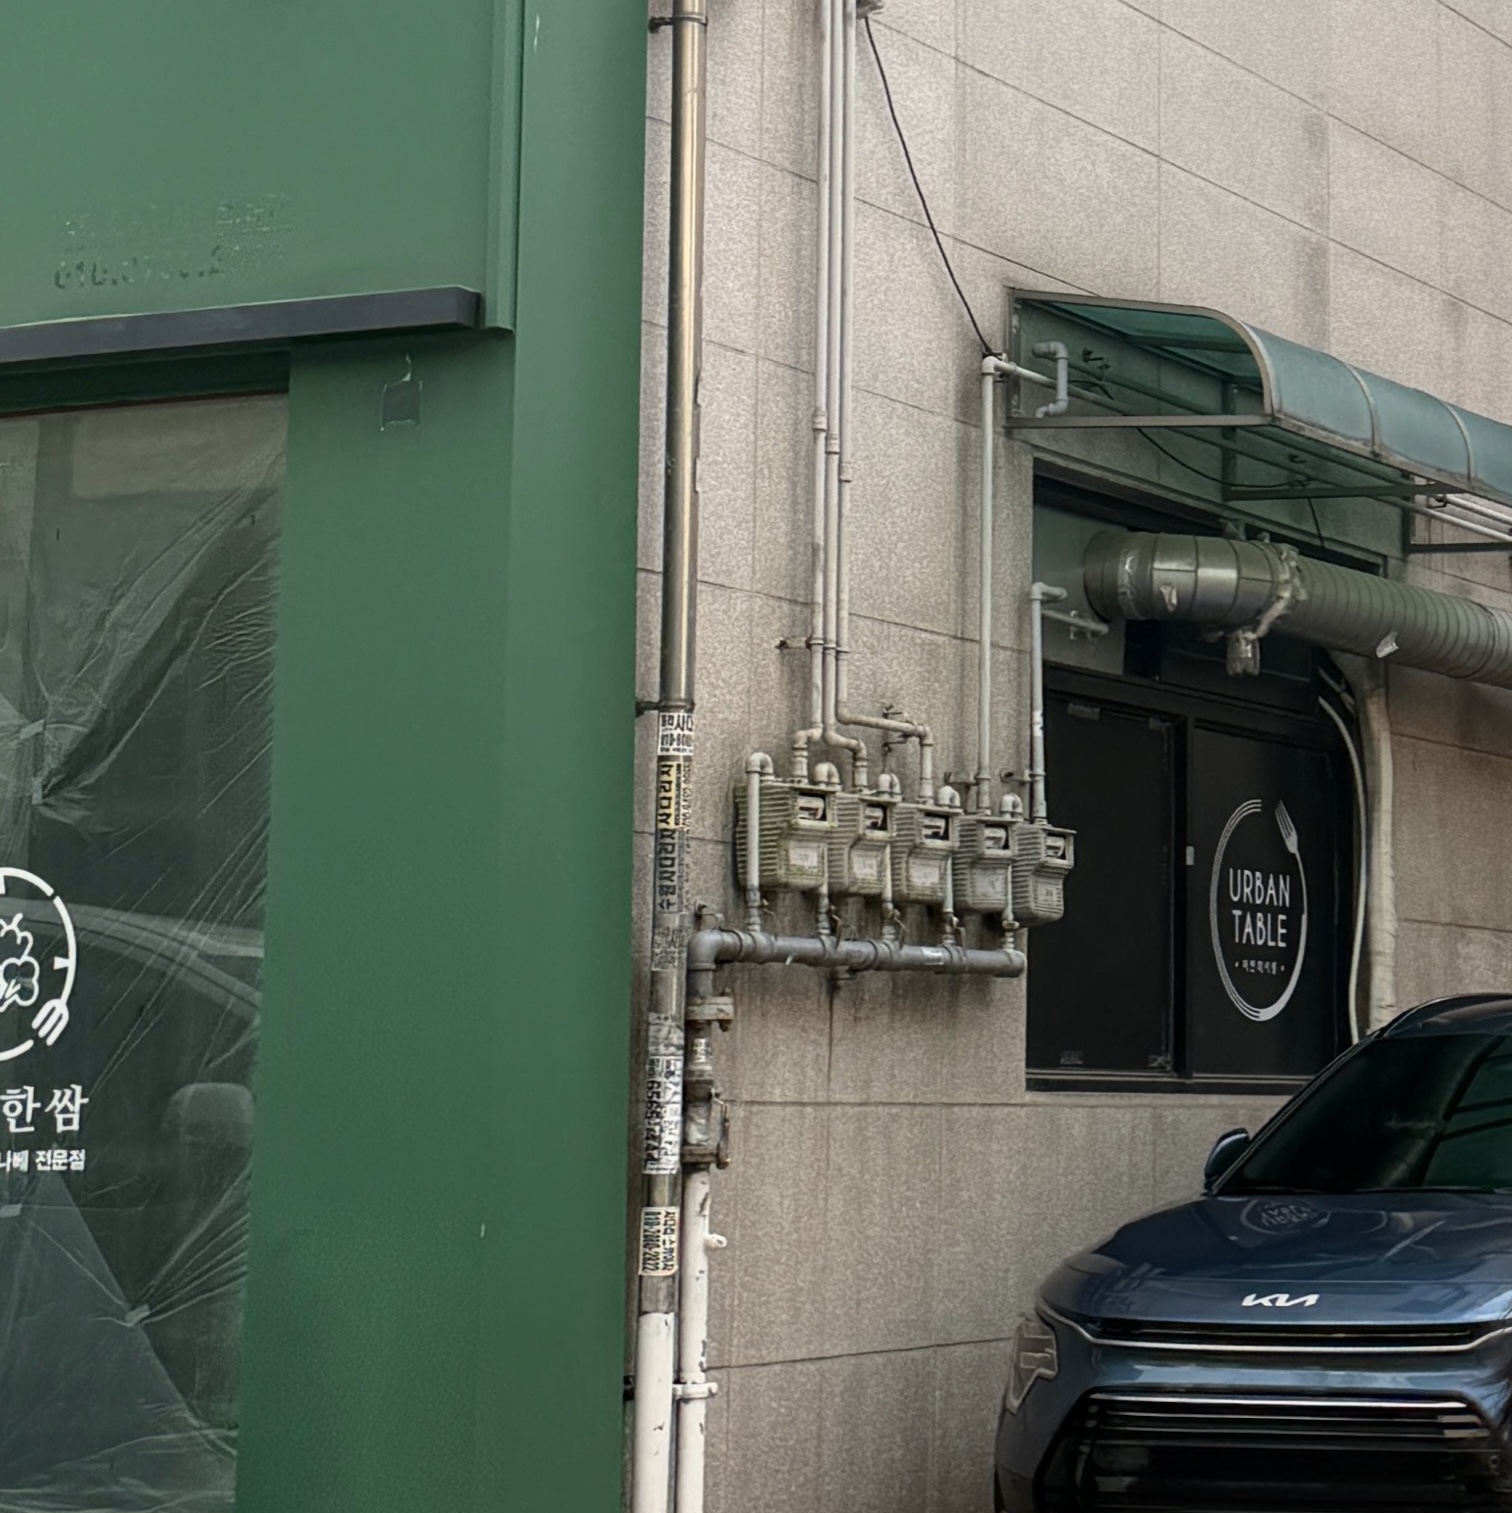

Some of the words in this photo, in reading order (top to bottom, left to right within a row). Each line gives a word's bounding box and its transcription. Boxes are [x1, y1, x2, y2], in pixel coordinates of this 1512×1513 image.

[1228, 867, 1290, 908] URBAN
[1231, 909, 1288, 948] TABLE
[35, 1148, 86, 1171] 전문점
[1241, 1293, 1320, 1307] KIA
